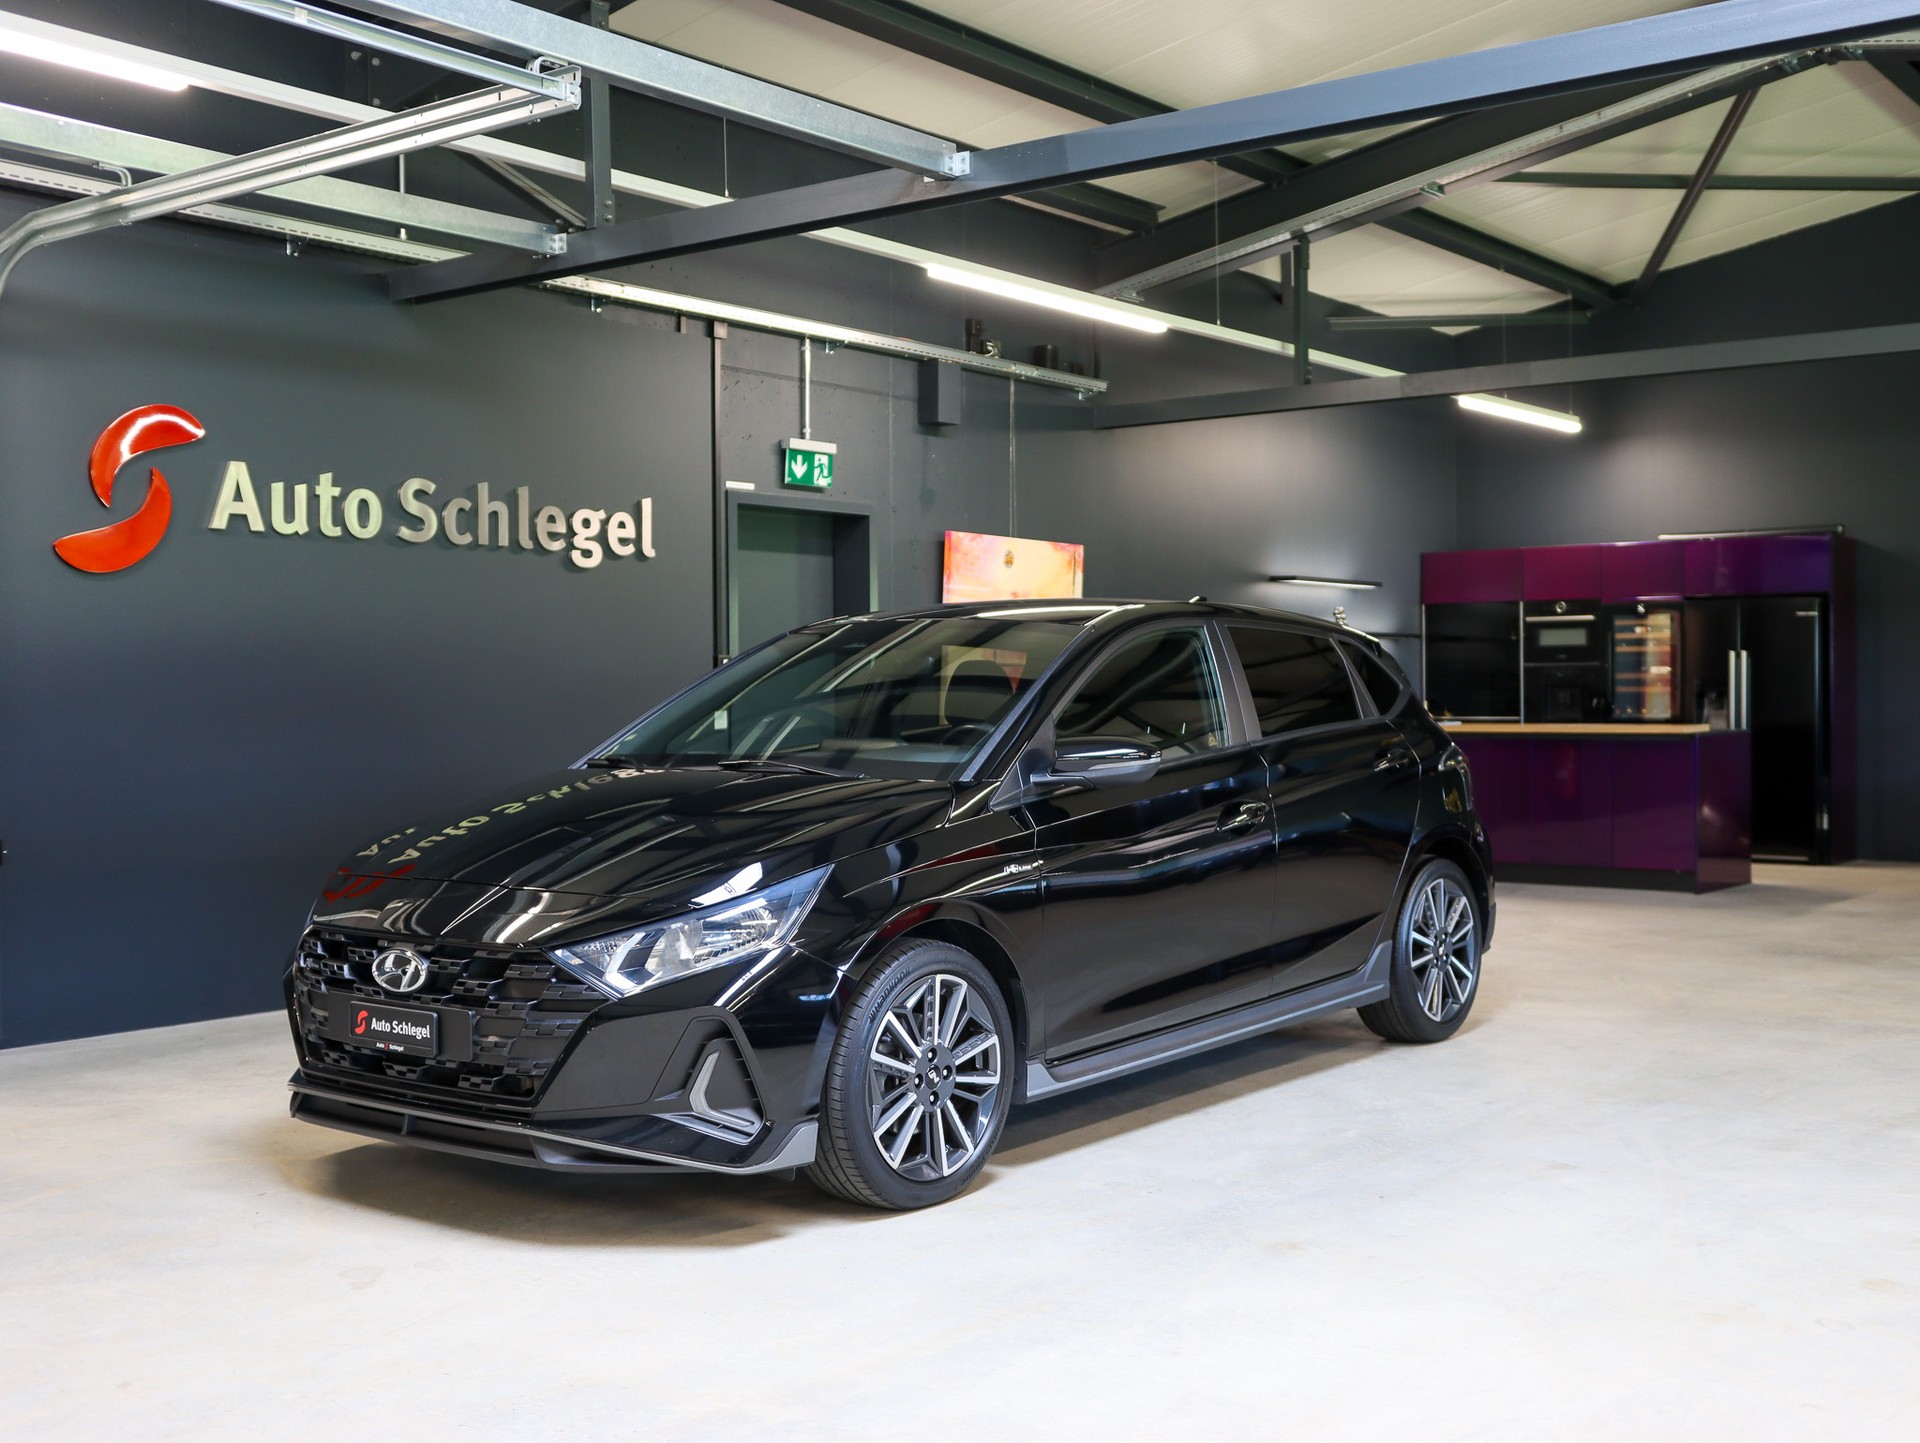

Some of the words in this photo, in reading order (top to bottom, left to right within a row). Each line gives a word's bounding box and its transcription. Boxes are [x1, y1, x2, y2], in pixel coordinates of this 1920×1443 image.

[208, 461, 382, 539] Auto
[396, 477, 656, 568] Schlegel
[371, 1018, 390, 1032] Auto
[392, 1021, 430, 1039] Schlegel
